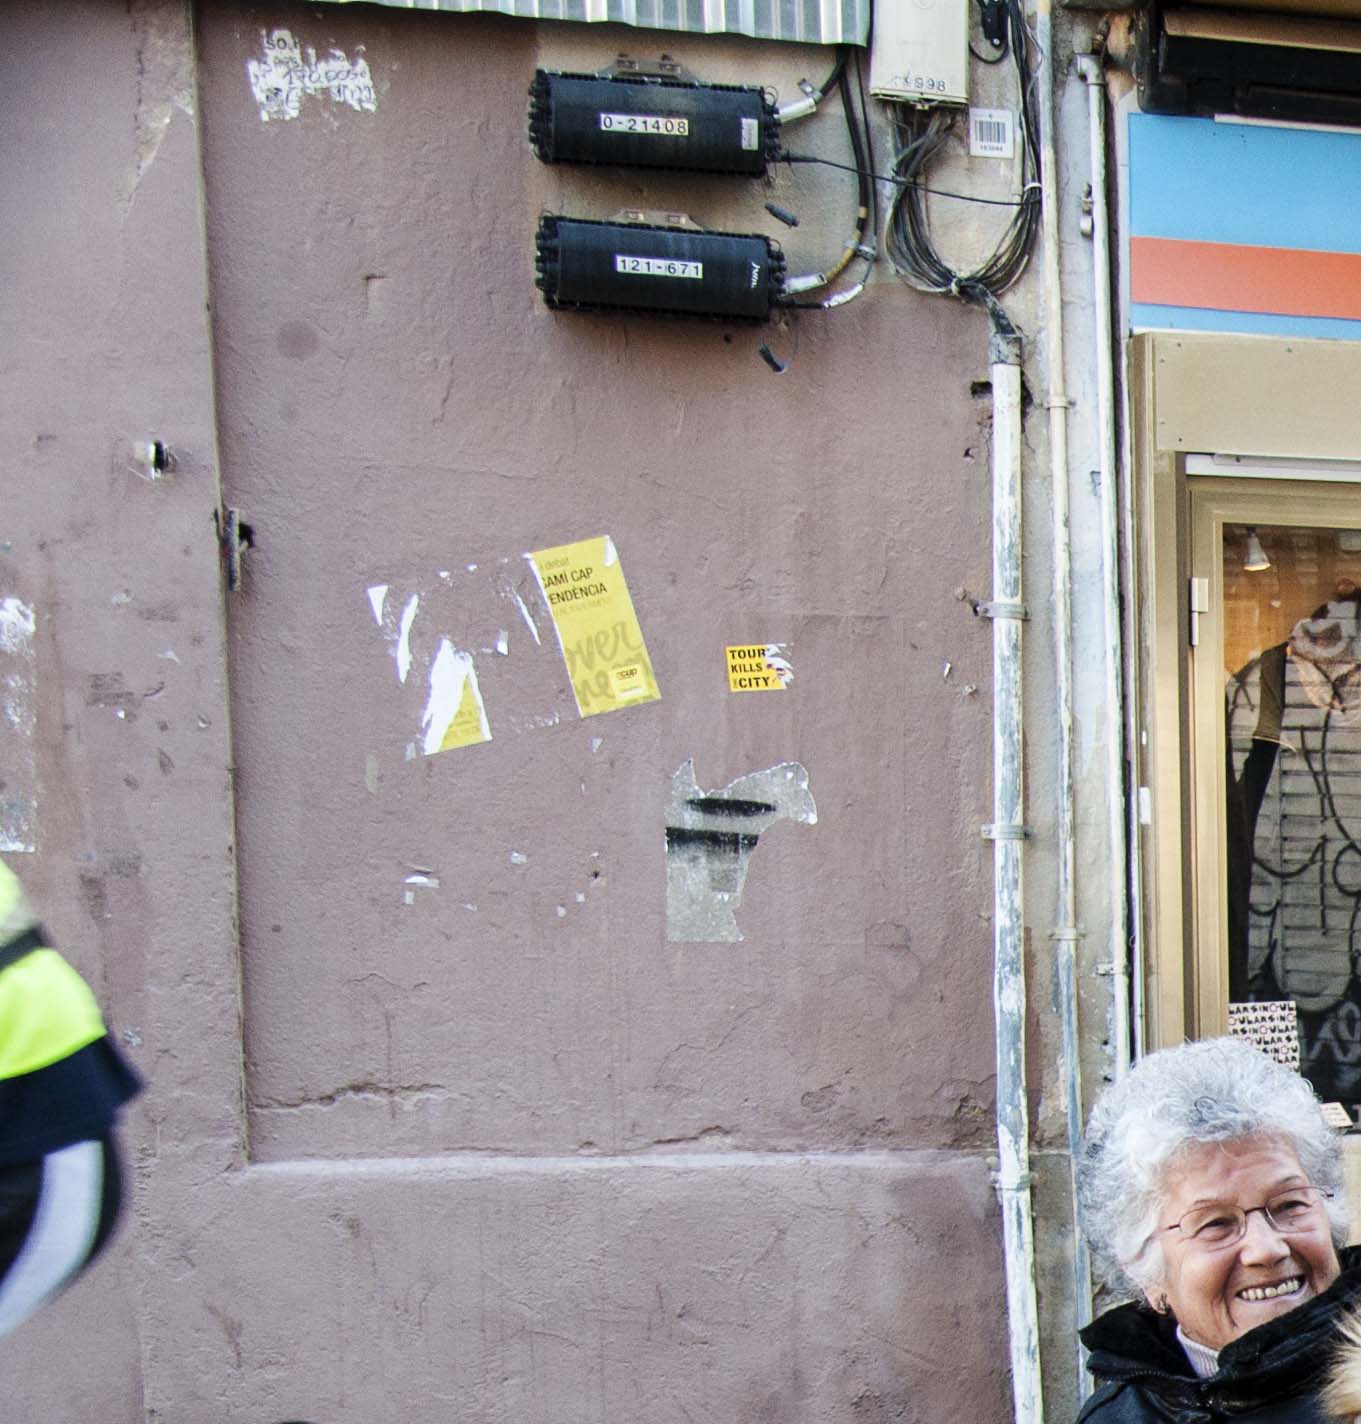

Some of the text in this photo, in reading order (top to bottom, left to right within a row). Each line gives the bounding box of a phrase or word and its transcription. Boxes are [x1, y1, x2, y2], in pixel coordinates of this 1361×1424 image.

[602, 116, 688, 135] 0-21408
[619, 258, 701, 277] 121-671
[571, 567, 594, 583] CAP
[731, 662, 763, 674] KILLS
[738, 676, 770, 689] CITY
